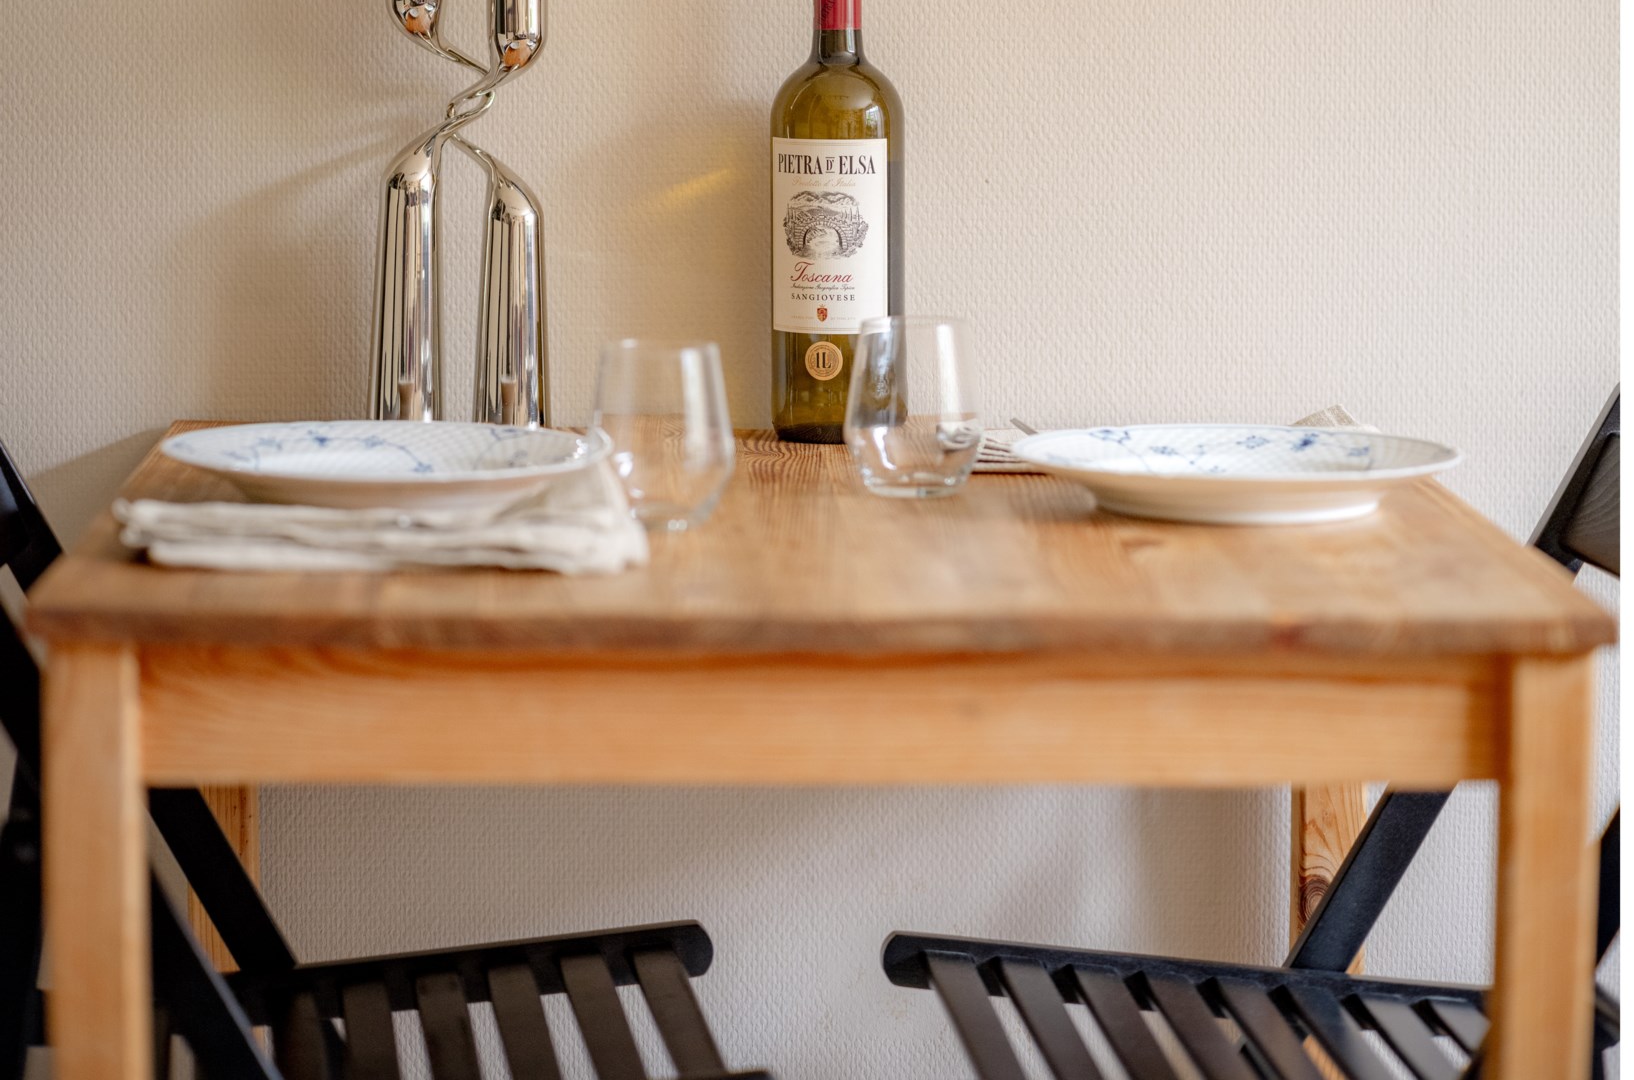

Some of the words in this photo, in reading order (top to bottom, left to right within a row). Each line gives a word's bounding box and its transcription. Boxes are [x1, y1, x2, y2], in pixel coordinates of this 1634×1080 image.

[778, 153, 823, 175] PIETRA
[838, 155, 876, 175] ELSA
[790, 261, 853, 283] Toscana
[791, 292, 856, 301] SANGIOVESE
